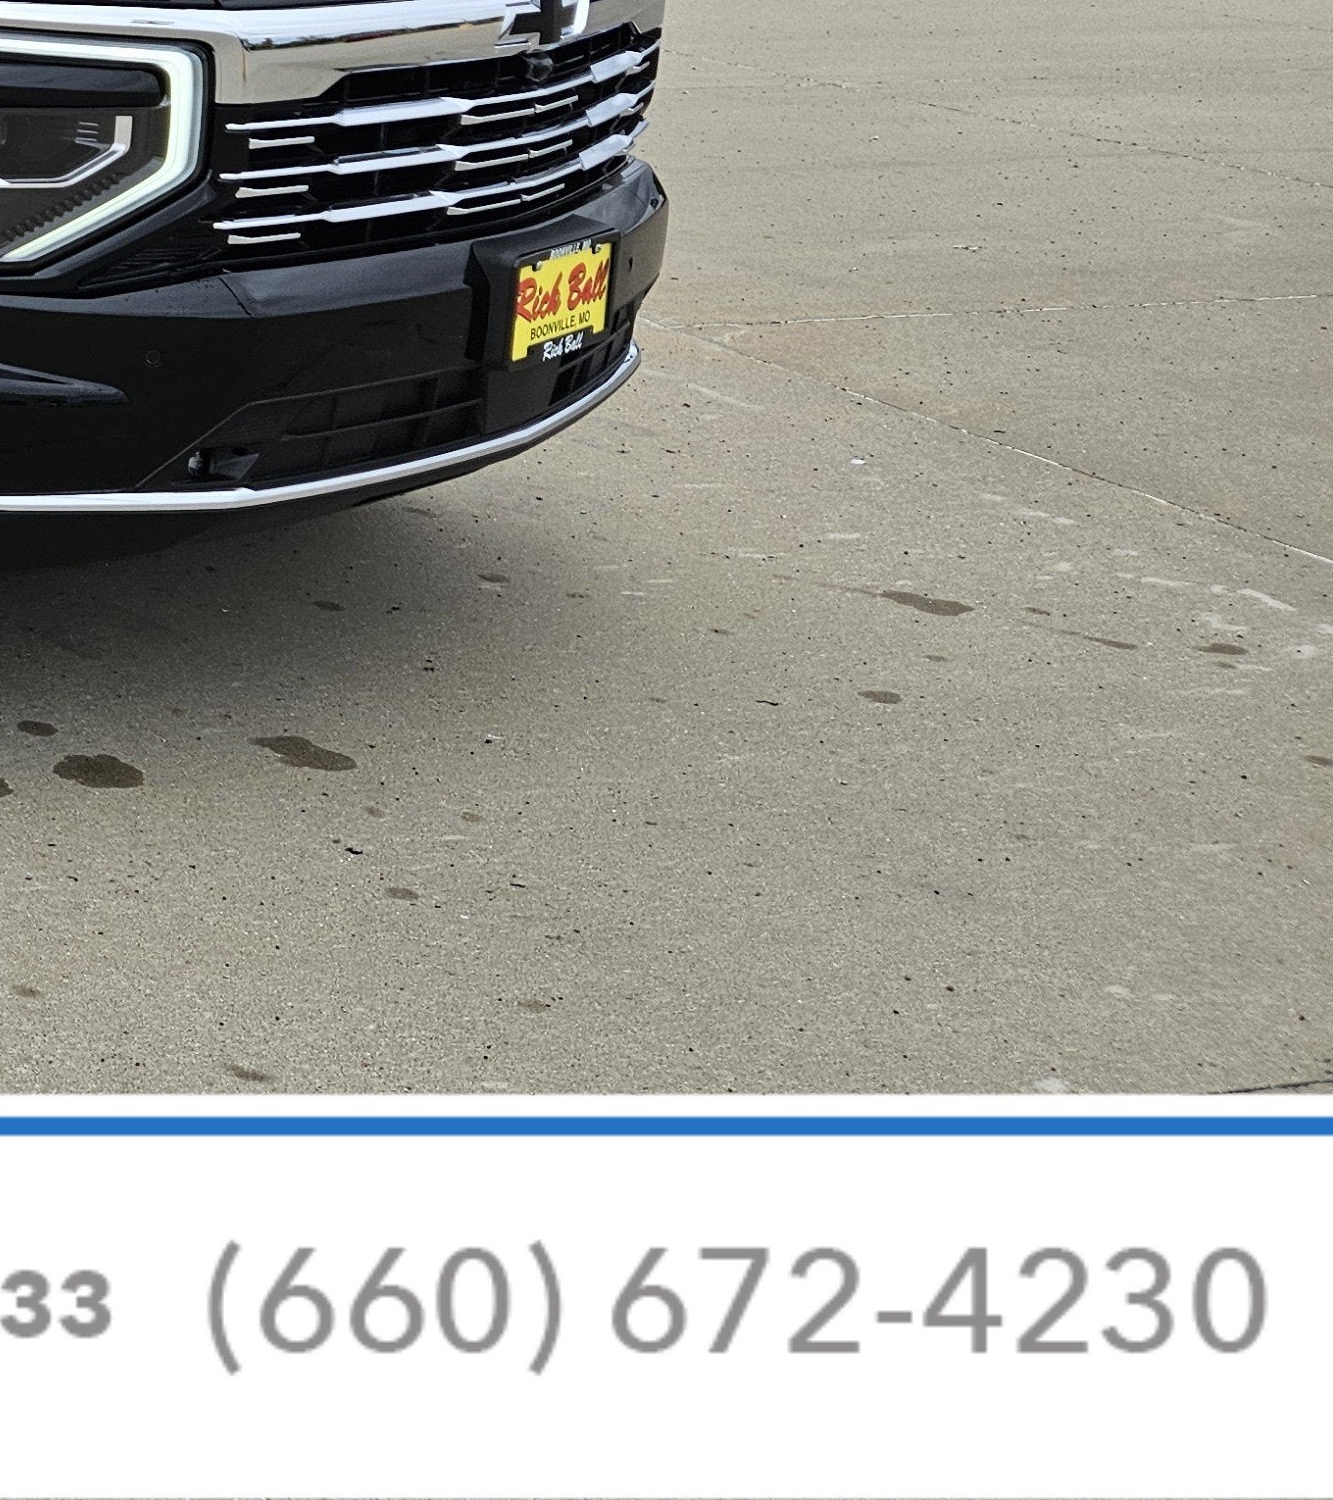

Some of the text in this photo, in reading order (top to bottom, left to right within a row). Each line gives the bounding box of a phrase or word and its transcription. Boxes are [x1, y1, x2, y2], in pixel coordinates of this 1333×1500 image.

[516, 257, 611, 323] Rick Ball
[578, 310, 591, 325] MO
[542, 331, 584, 362] Rick Ball
